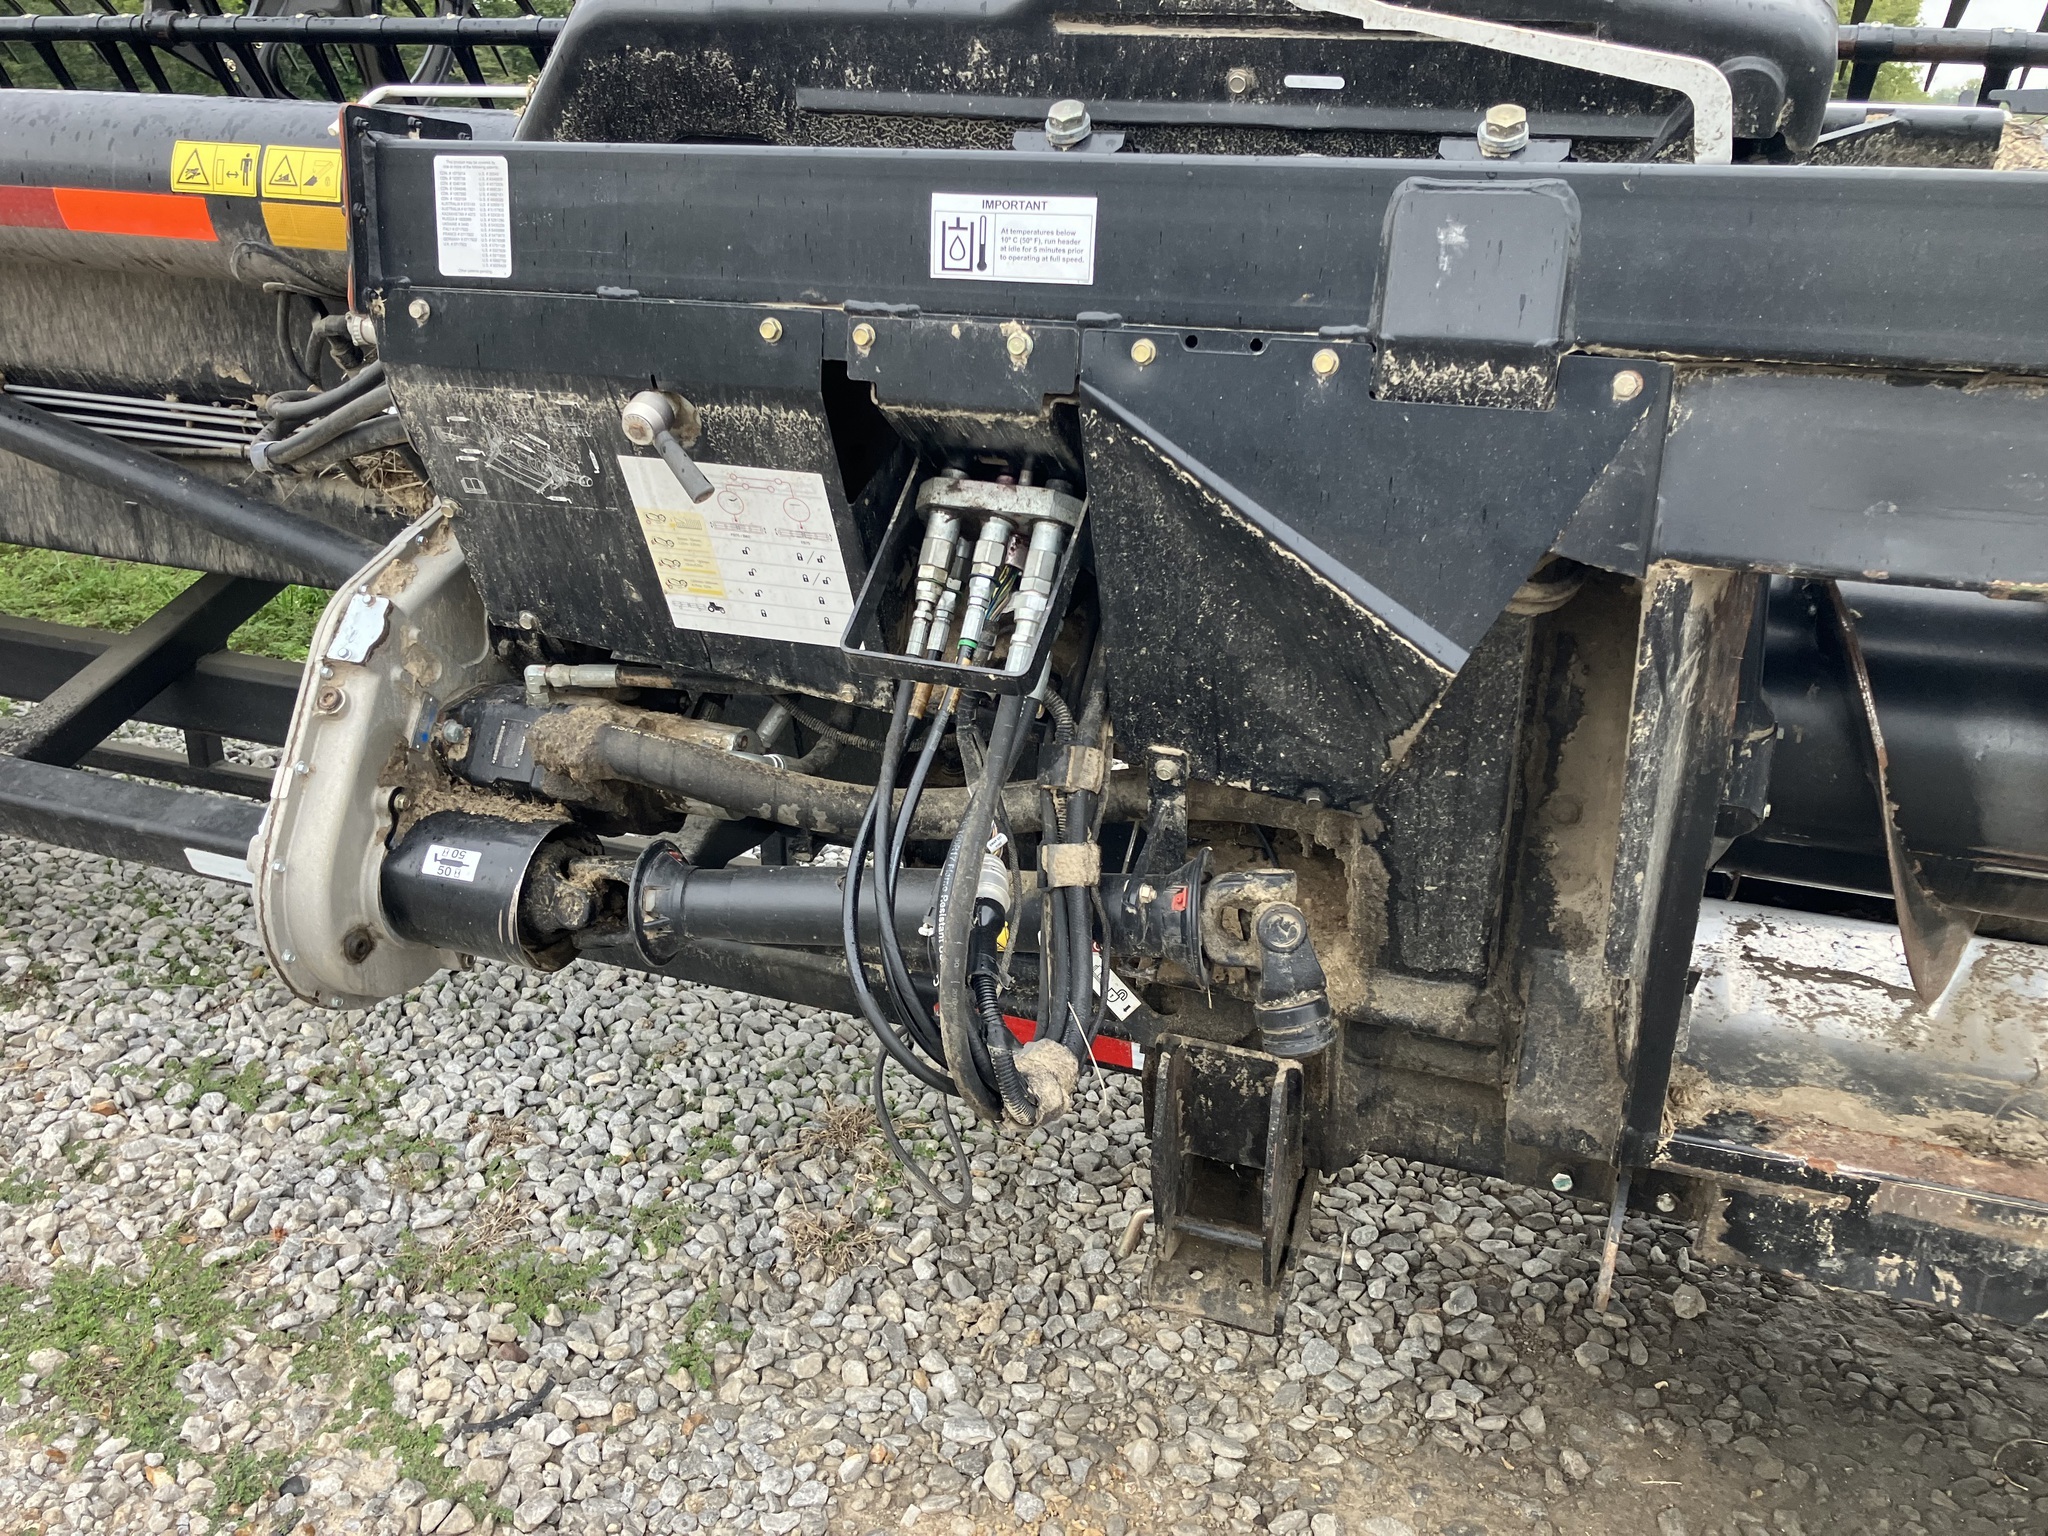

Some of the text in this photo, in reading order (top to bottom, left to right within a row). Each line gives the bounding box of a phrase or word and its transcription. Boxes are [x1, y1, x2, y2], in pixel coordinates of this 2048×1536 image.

[982, 199, 1048, 211] IMPORTANT
[1010, 228, 1054, 237] temperatures
[1008, 255, 1040, 263] operating
[451, 850, 466, 859] 50
[437, 866, 452, 876] 50
[942, 864, 954, 892] Flame
[938, 894, 948, 943] Resistant
